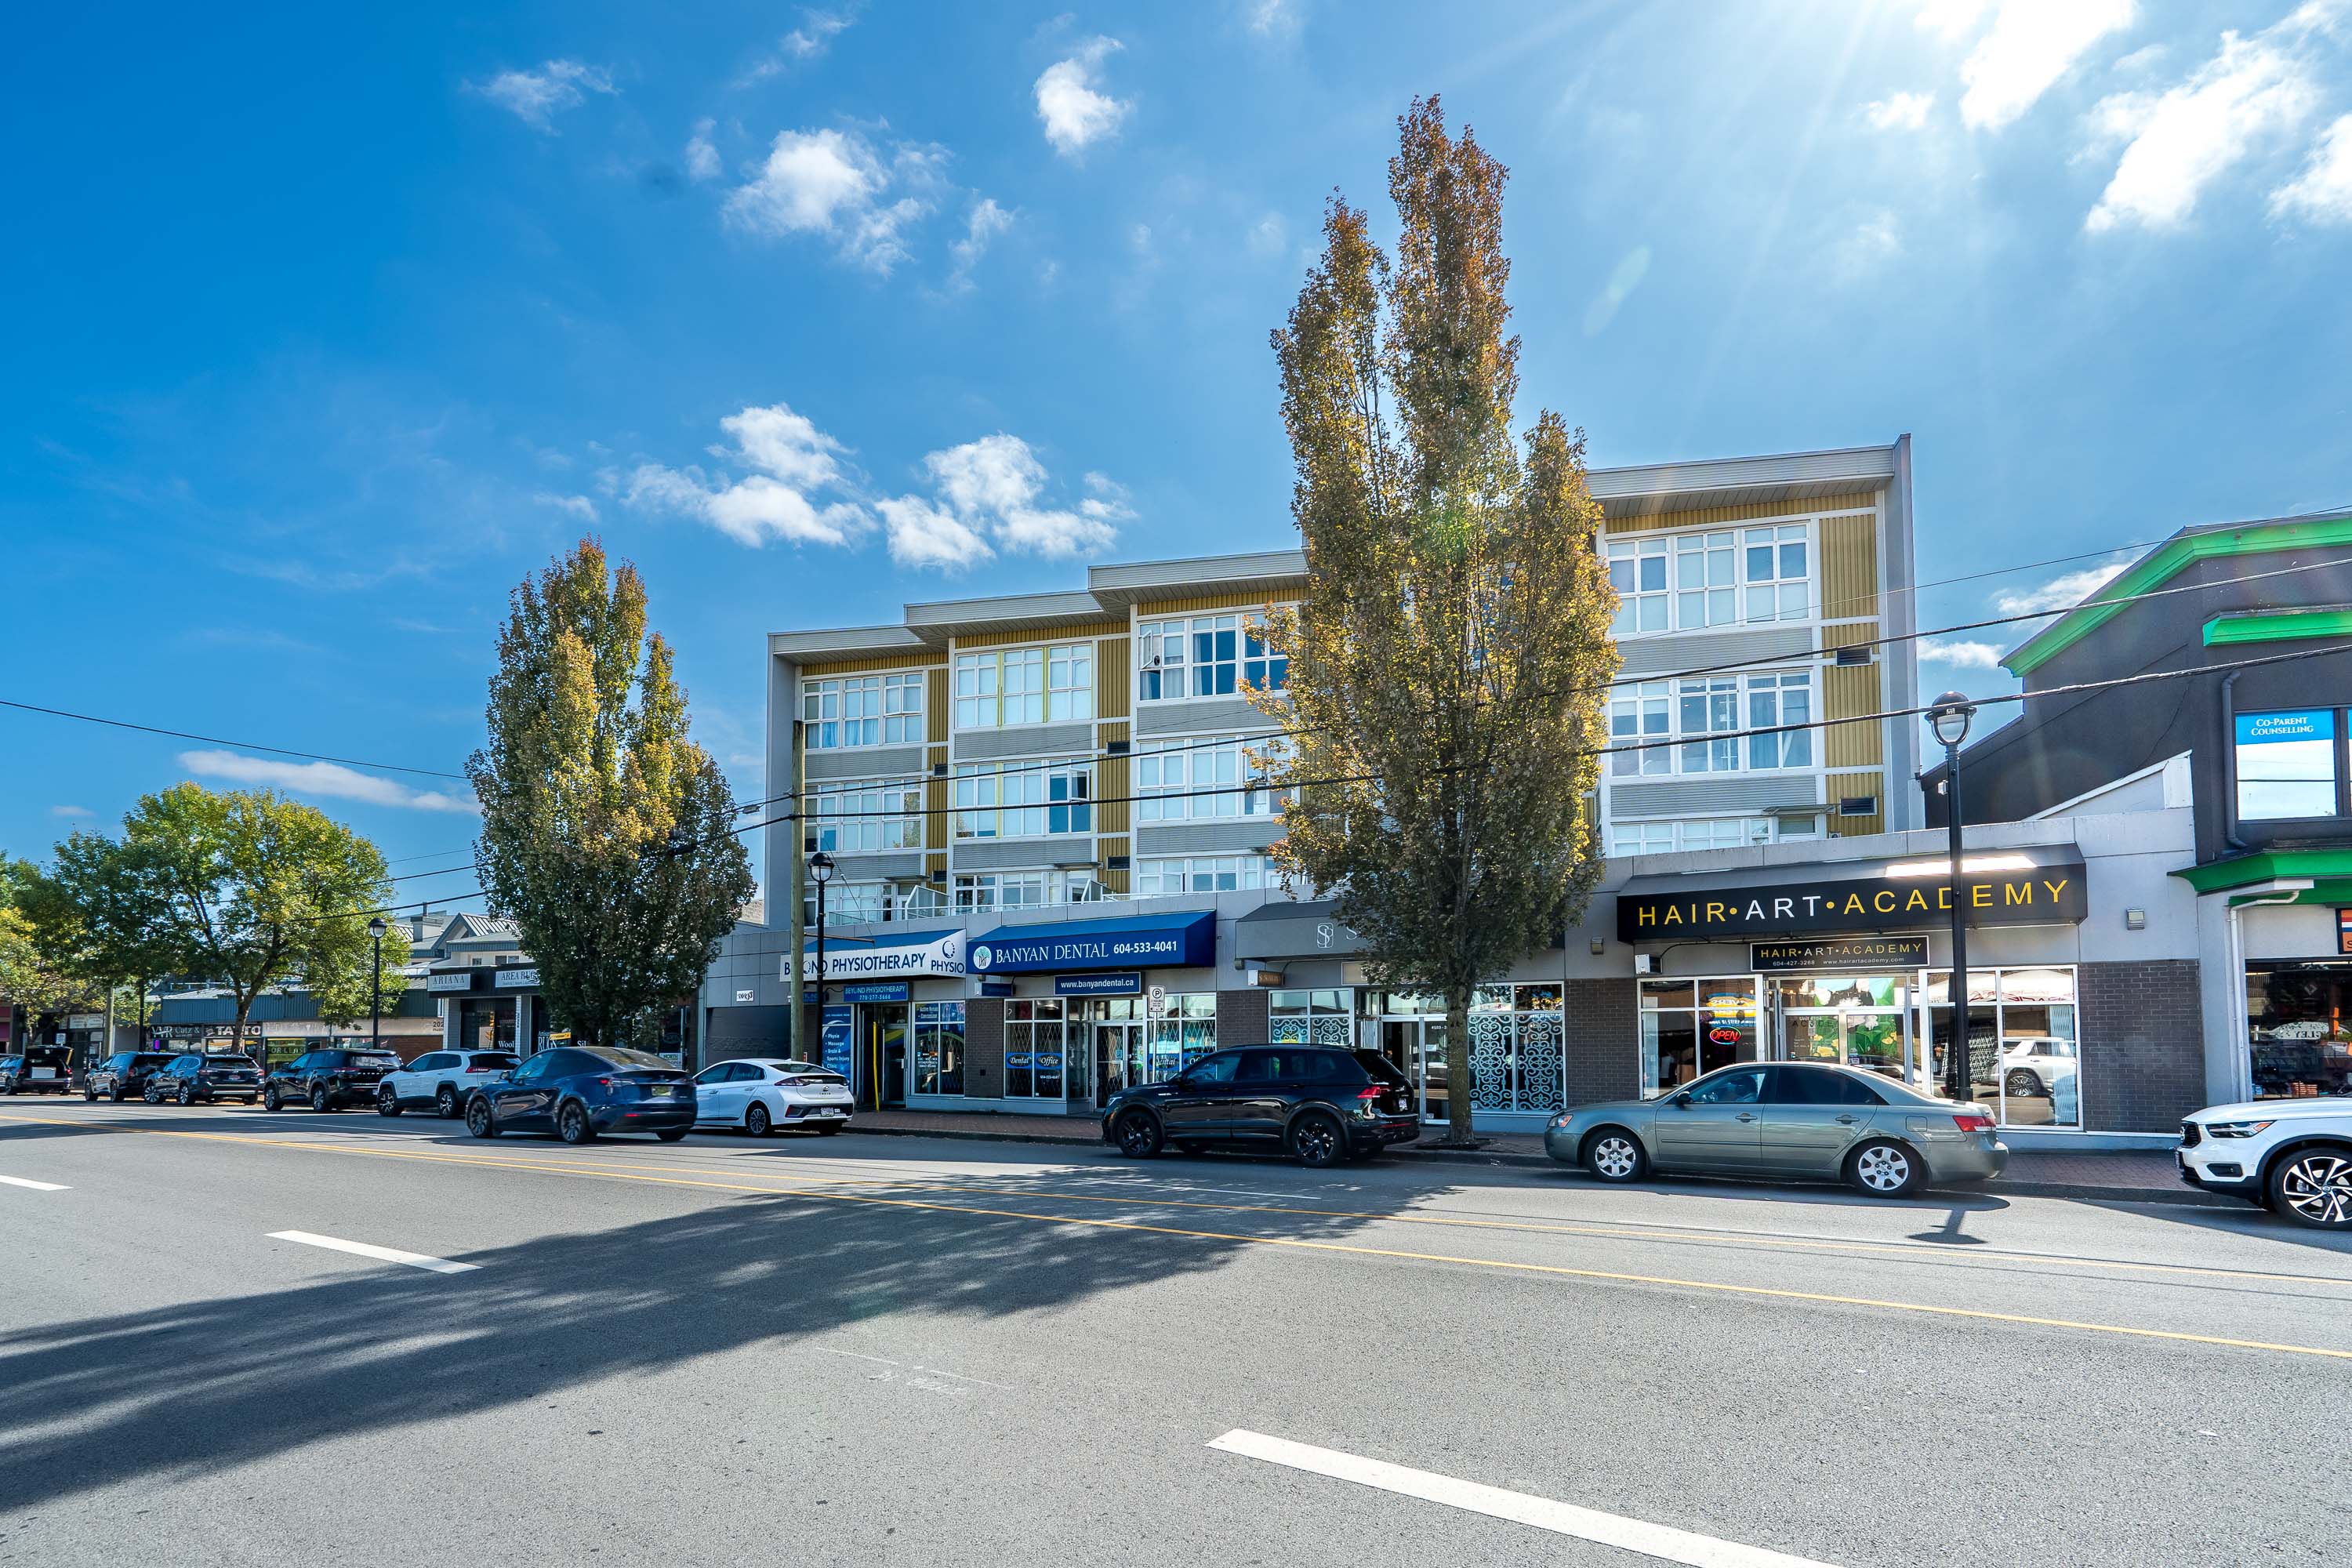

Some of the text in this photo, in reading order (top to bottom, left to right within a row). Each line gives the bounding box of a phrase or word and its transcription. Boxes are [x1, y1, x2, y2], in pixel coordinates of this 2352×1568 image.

[1639, 902, 1726, 927] HAIR
[1745, 895, 1821, 920] ART
[996, 940, 1177, 964] BANYAN DENTAL 604-533-4041
[1761, 943, 1921, 958] HAIR ART ACADEMY
[833, 953, 927, 973] PHYSIOTHERAPY
[1823, 956, 1904, 965] www.hairartacademy.com
[931, 959, 965, 974] PHYSIO
[433, 975, 465, 985] ARIANA
[502, 970, 539, 980] AREA RUG
[1061, 978, 1134, 989] www.banyandental.ca
[1711, 1030, 1739, 1040] OPEN
[1040, 1056, 1058, 1065] Office
